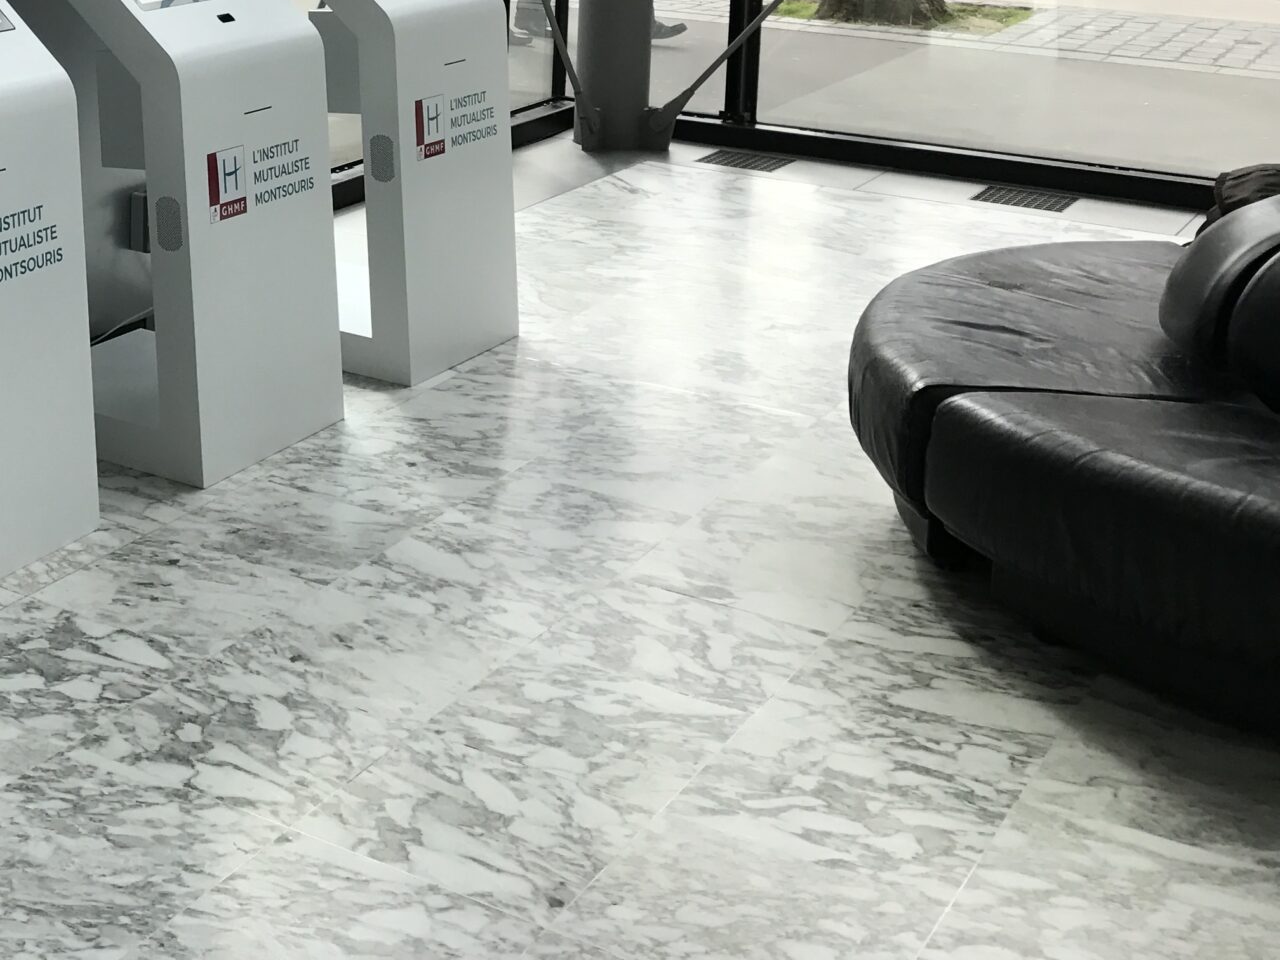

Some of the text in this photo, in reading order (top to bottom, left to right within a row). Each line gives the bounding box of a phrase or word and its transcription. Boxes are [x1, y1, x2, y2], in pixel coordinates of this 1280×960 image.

[450, 106, 495, 130] MUTUALISTE
[451, 124, 498, 148] MONTSOURIS
[252, 139, 300, 164] L'INSTITUT
[253, 156, 310, 185] MUTUALISTE
[255, 176, 315, 207] MONTSOURIS
[221, 200, 245, 216] GHMF
